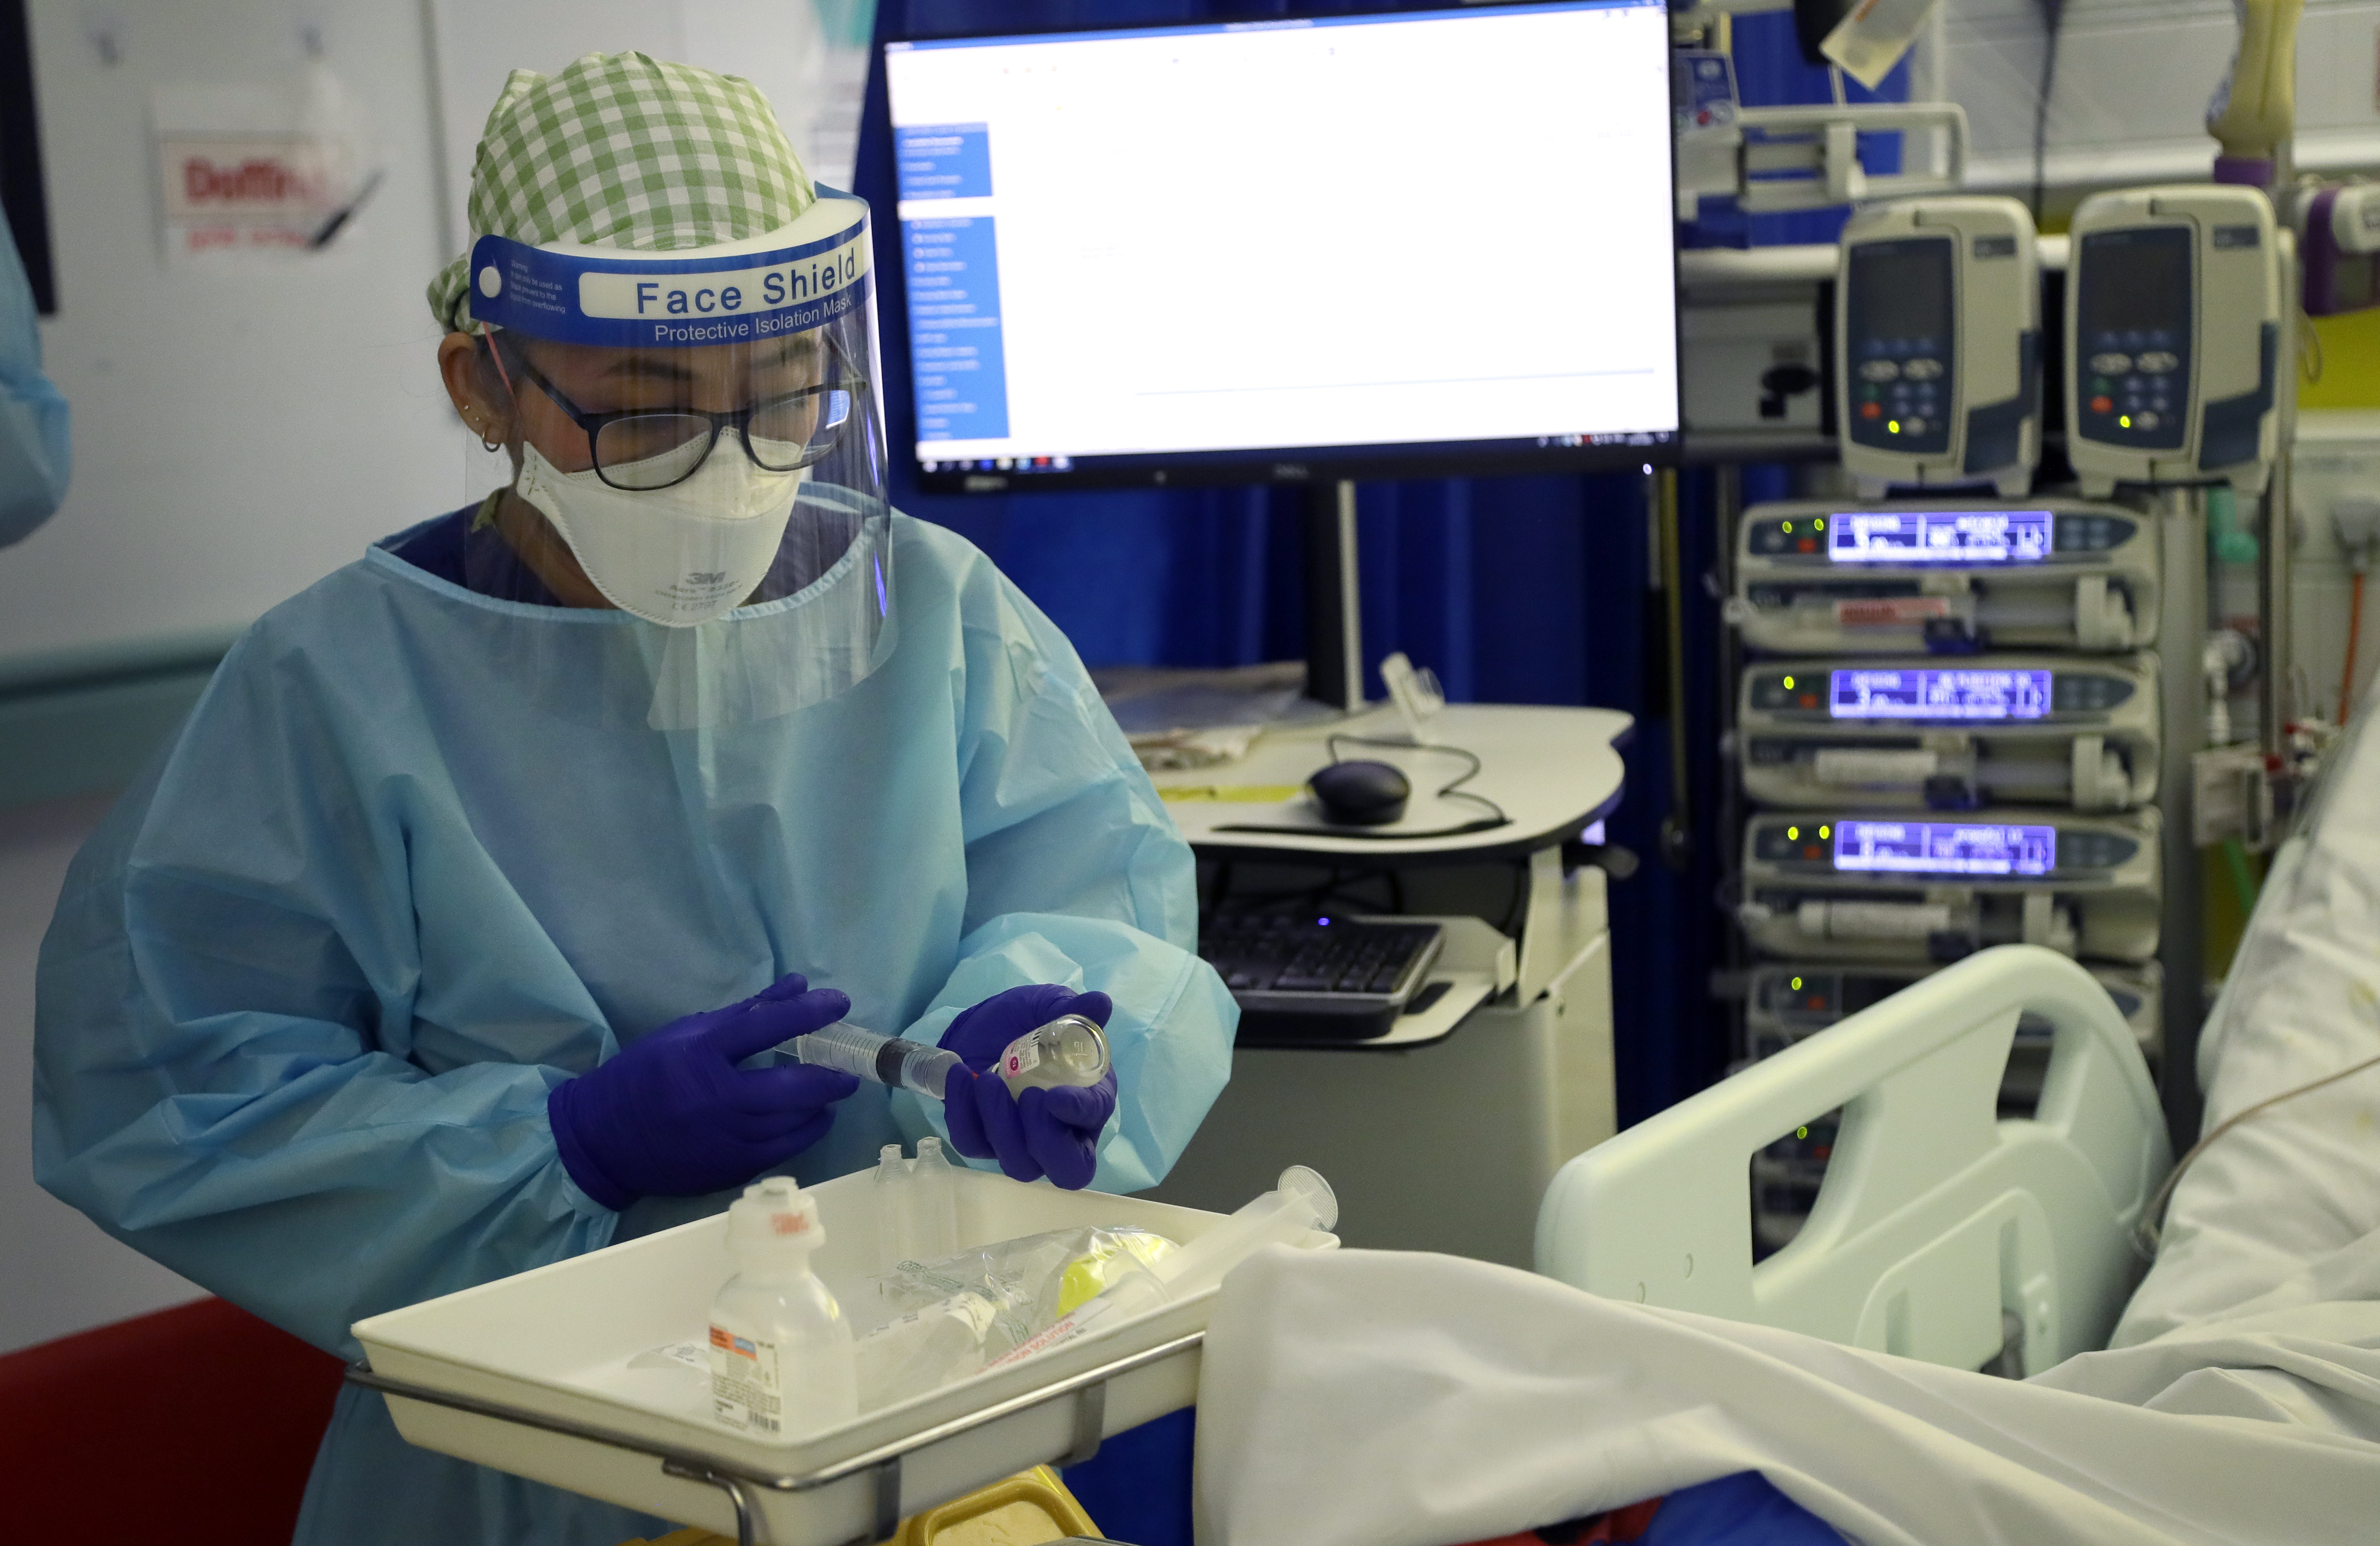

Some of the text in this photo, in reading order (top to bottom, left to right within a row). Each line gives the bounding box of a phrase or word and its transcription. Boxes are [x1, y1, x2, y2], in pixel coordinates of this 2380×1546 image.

[532, 277, 538, 285] be
[637, 247, 856, 314] Face Shield
[532, 302, 565, 314] overflowing
[655, 293, 852, 342] Protective Isolation Mask
[686, 571, 726, 585] 3M
